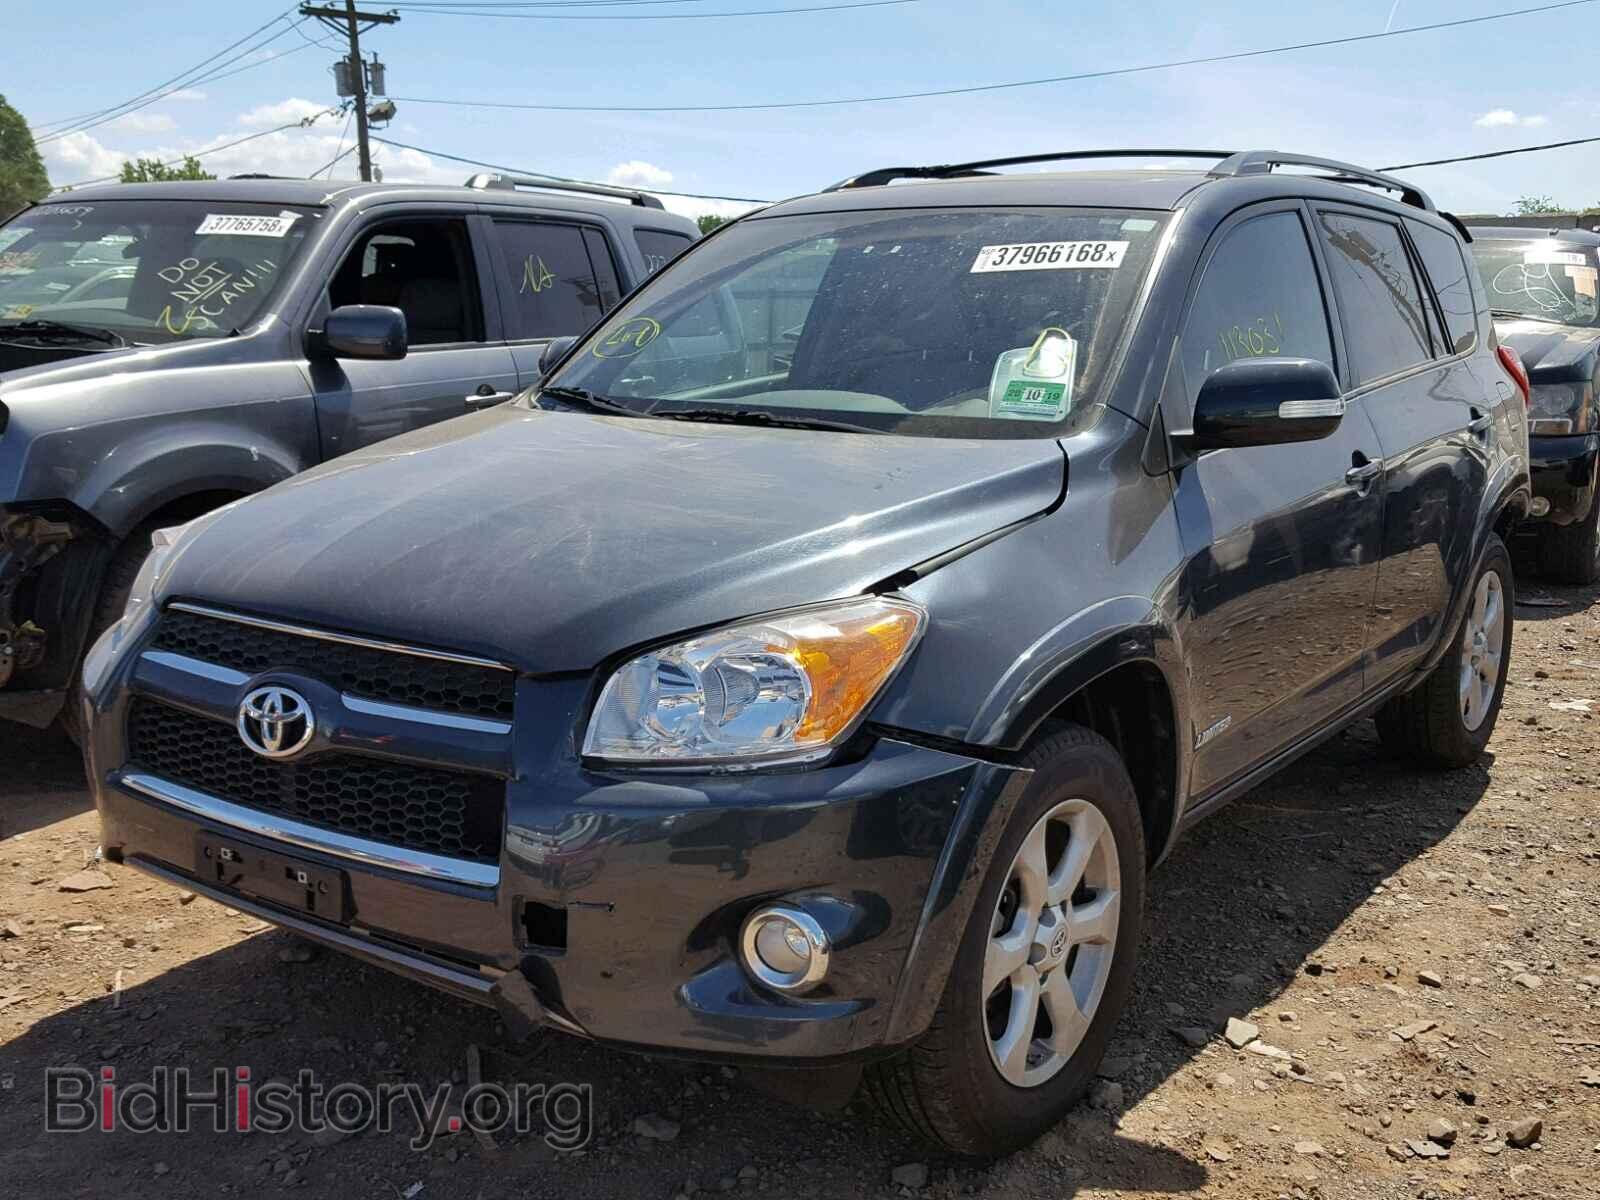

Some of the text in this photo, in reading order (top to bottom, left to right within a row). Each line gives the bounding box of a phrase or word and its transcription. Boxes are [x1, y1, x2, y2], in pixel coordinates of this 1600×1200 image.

[157, 257, 200, 283] DO
[171, 262, 227, 302] NOT
[1025, 389, 1041, 400] 10
